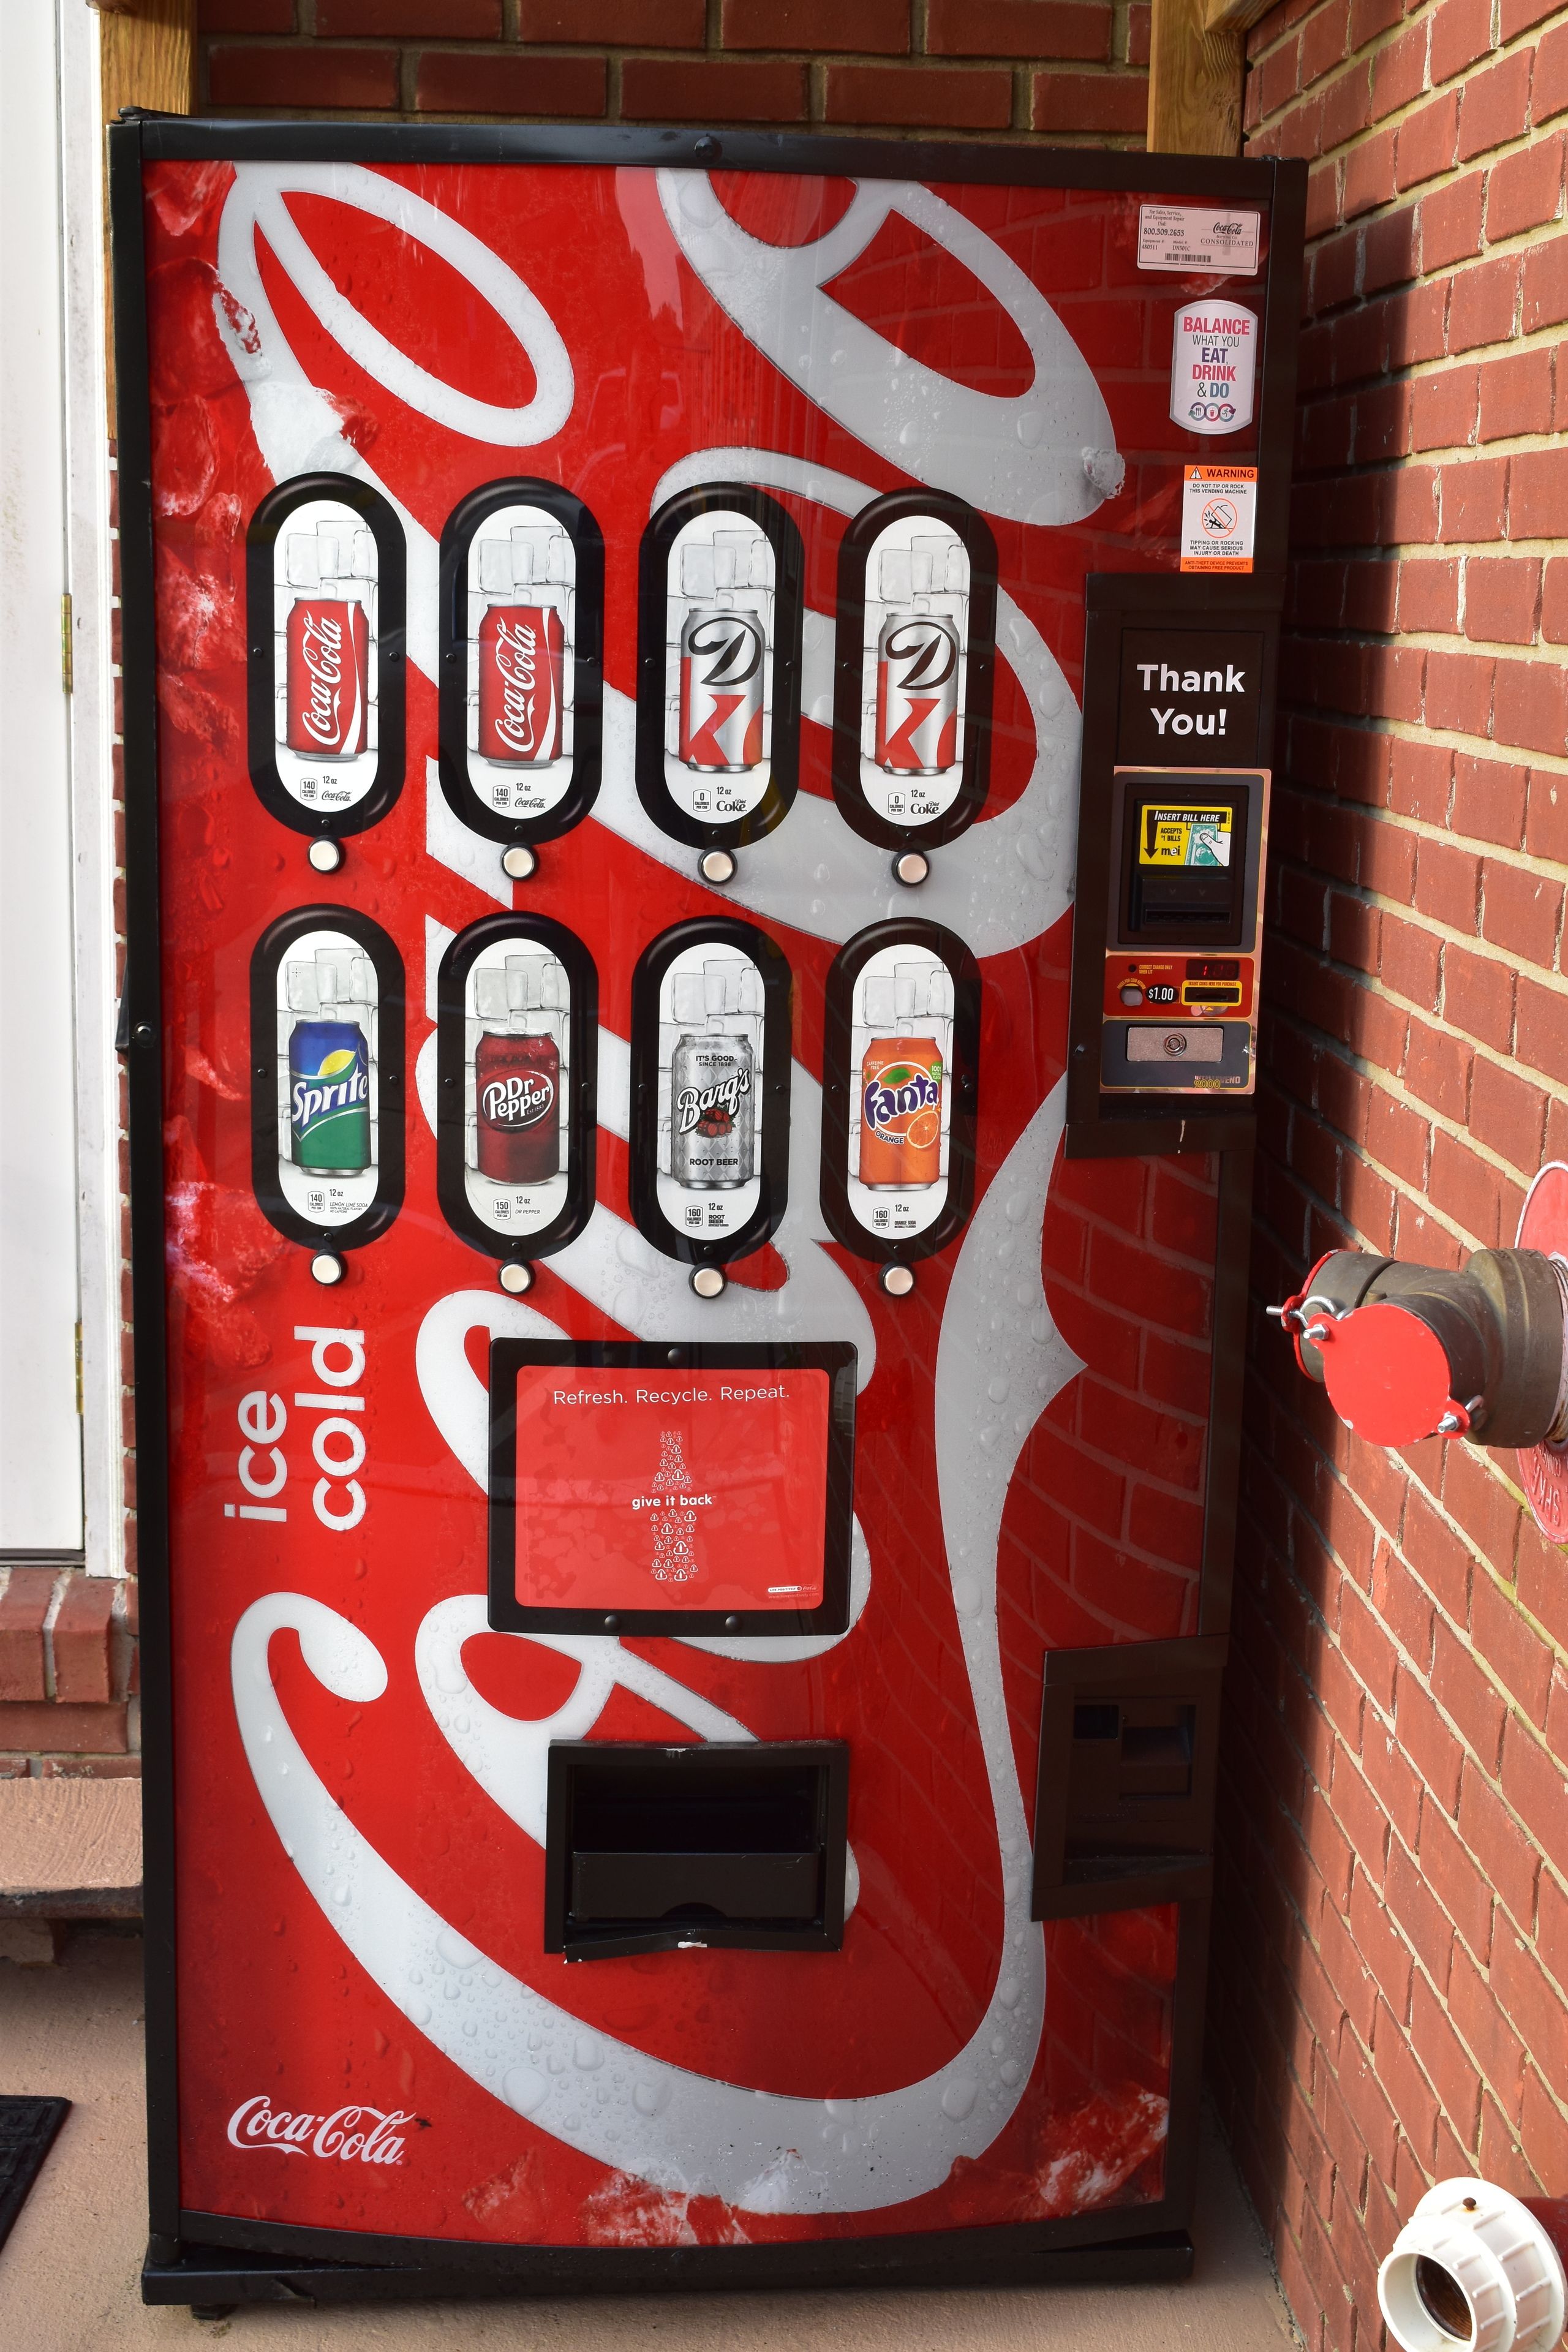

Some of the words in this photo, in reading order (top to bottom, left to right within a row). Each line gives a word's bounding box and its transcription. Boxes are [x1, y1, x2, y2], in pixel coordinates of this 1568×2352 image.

[1144, 227, 1185, 236] 800.309.2653
[1213, 222, 1243, 235] Coca-Cola
[1183, 316, 1250, 335] BALANCE
[1192, 334, 1219, 346] WHAT
[1221, 336, 1240, 347] YOU
[1201, 347, 1228, 365] EAT,
[1192, 364, 1236, 382] DRINK
[1197, 382, 1207, 398] &
[1210, 382, 1229, 398] DO
[1207, 469, 1254, 478] WARNING
[302, 610, 342, 746] Coca-Cola
[495, 616, 537, 752] Coca-Cola
[1137, 663, 1245, 692] Thank
[1150, 708, 1227, 735] You!
[303, 781, 315, 790] 140
[323, 775, 330, 784] 12
[516, 782, 523, 791] 12
[496, 788, 508, 797] 140
[699, 793, 704, 801] 0
[716, 786, 724, 795] 12
[910, 789, 918, 797] 12
[716, 800, 747, 812] Coke
[894, 795, 899, 804] 0
[910, 803, 940, 814] Coke
[1154, 810, 1181, 821] INSERT
[1148, 987, 1174, 1001] $1.00
[506, 1076, 534, 1101] Dr
[1194, 1079, 1221, 1089] 2000
[292, 1063, 368, 1128] Sprite
[488, 1080, 551, 1121] Pepper
[677, 1067, 750, 1134] Barq's
[864, 1073, 939, 1131] Fanta
[875, 1130, 904, 1144] ORANGE
[330, 1188, 336, 1197] 12
[516, 1196, 523, 1204] 12
[553, 1390, 628, 1404] Refresh.
[636, 1387, 712, 1405] Recycle.
[720, 1384, 790, 1402] Repeat.
[293, 1325, 366, 1531] cold
[224, 1390, 288, 1523] ice
[631, 1496, 661, 1510] give
[666, 1495, 676, 1506] it
[680, 1493, 712, 1506] back
[227, 2095, 417, 2165] Coca-Cola
